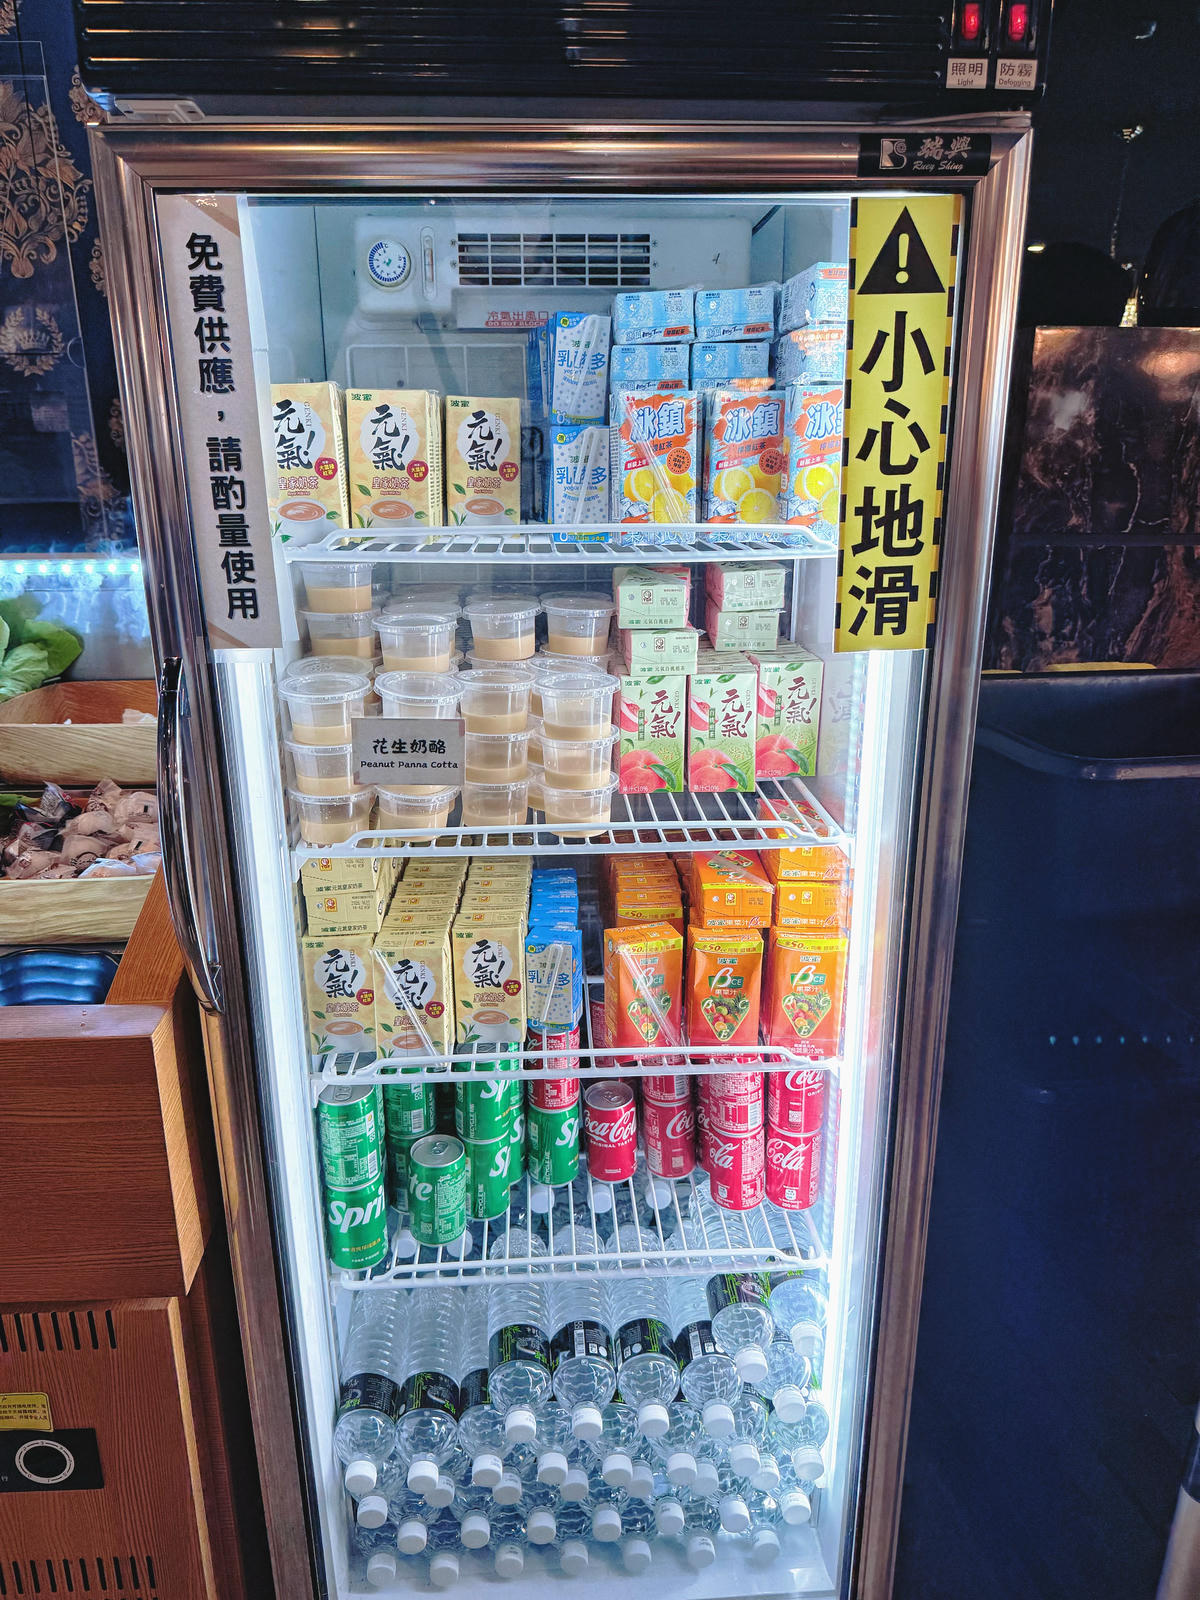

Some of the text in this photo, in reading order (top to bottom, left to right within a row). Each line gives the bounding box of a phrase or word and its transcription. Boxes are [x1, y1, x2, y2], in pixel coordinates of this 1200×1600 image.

[951, 62, 984, 76] 照明
[957, 78, 974, 87] Light
[998, 78, 1032, 87] Defogging
[723, 402, 781, 443] 冰鎮
[848, 310, 936, 636] 小心地滑
[372, 737, 447, 755] 花生奶酪
[360, 760, 459, 769] Peanut Panna Cotta
